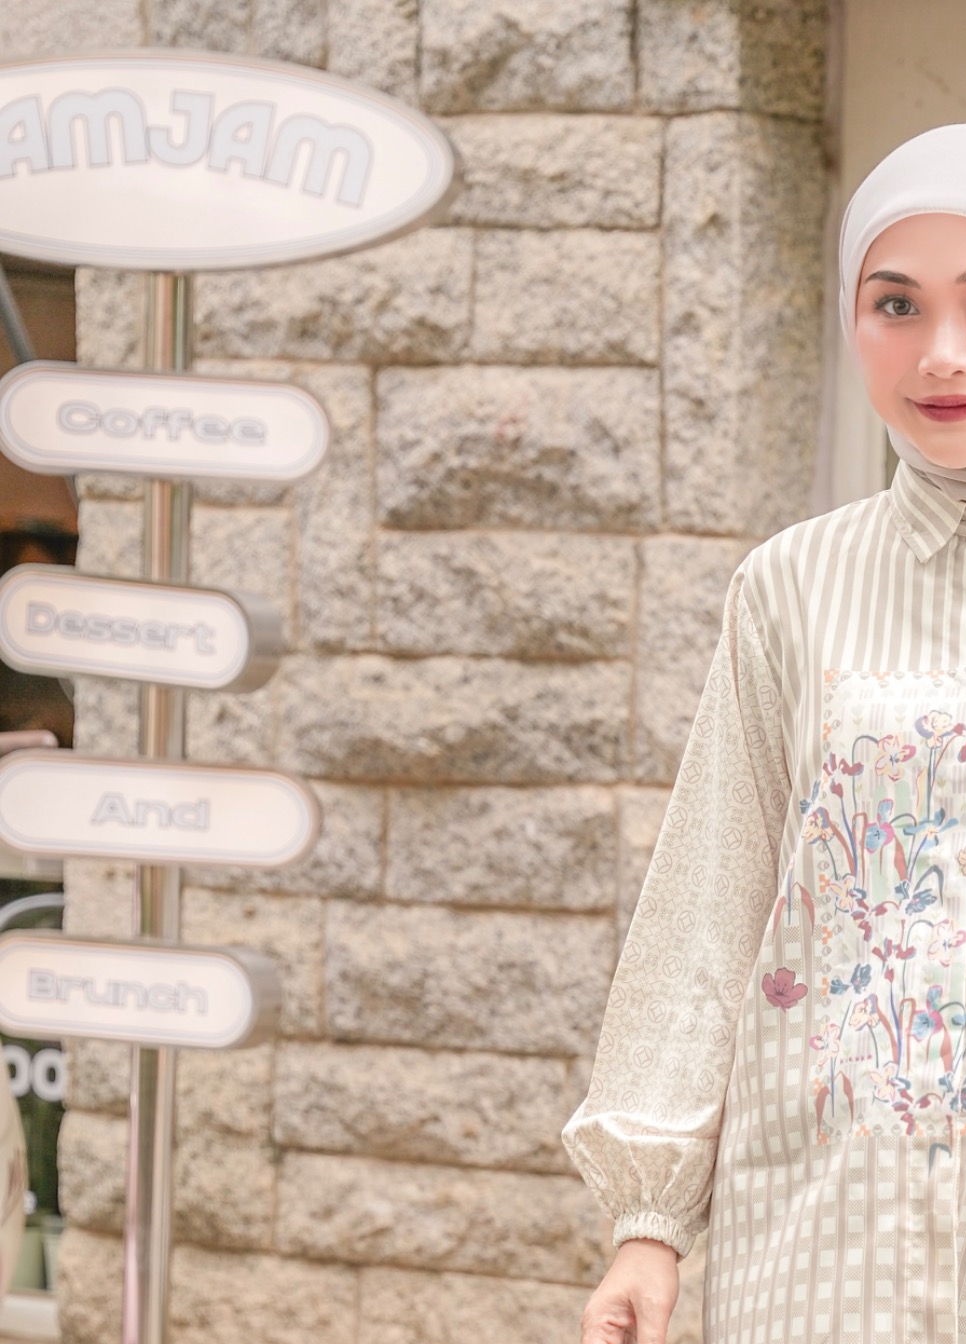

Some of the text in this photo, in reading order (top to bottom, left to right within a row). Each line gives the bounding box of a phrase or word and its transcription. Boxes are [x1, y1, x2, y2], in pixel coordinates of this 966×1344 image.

[56, 400, 269, 445] Coffee
[24, 600, 217, 655] Dessert
[90, 792, 212, 832] And
[27, 968, 210, 1018] Brunch
